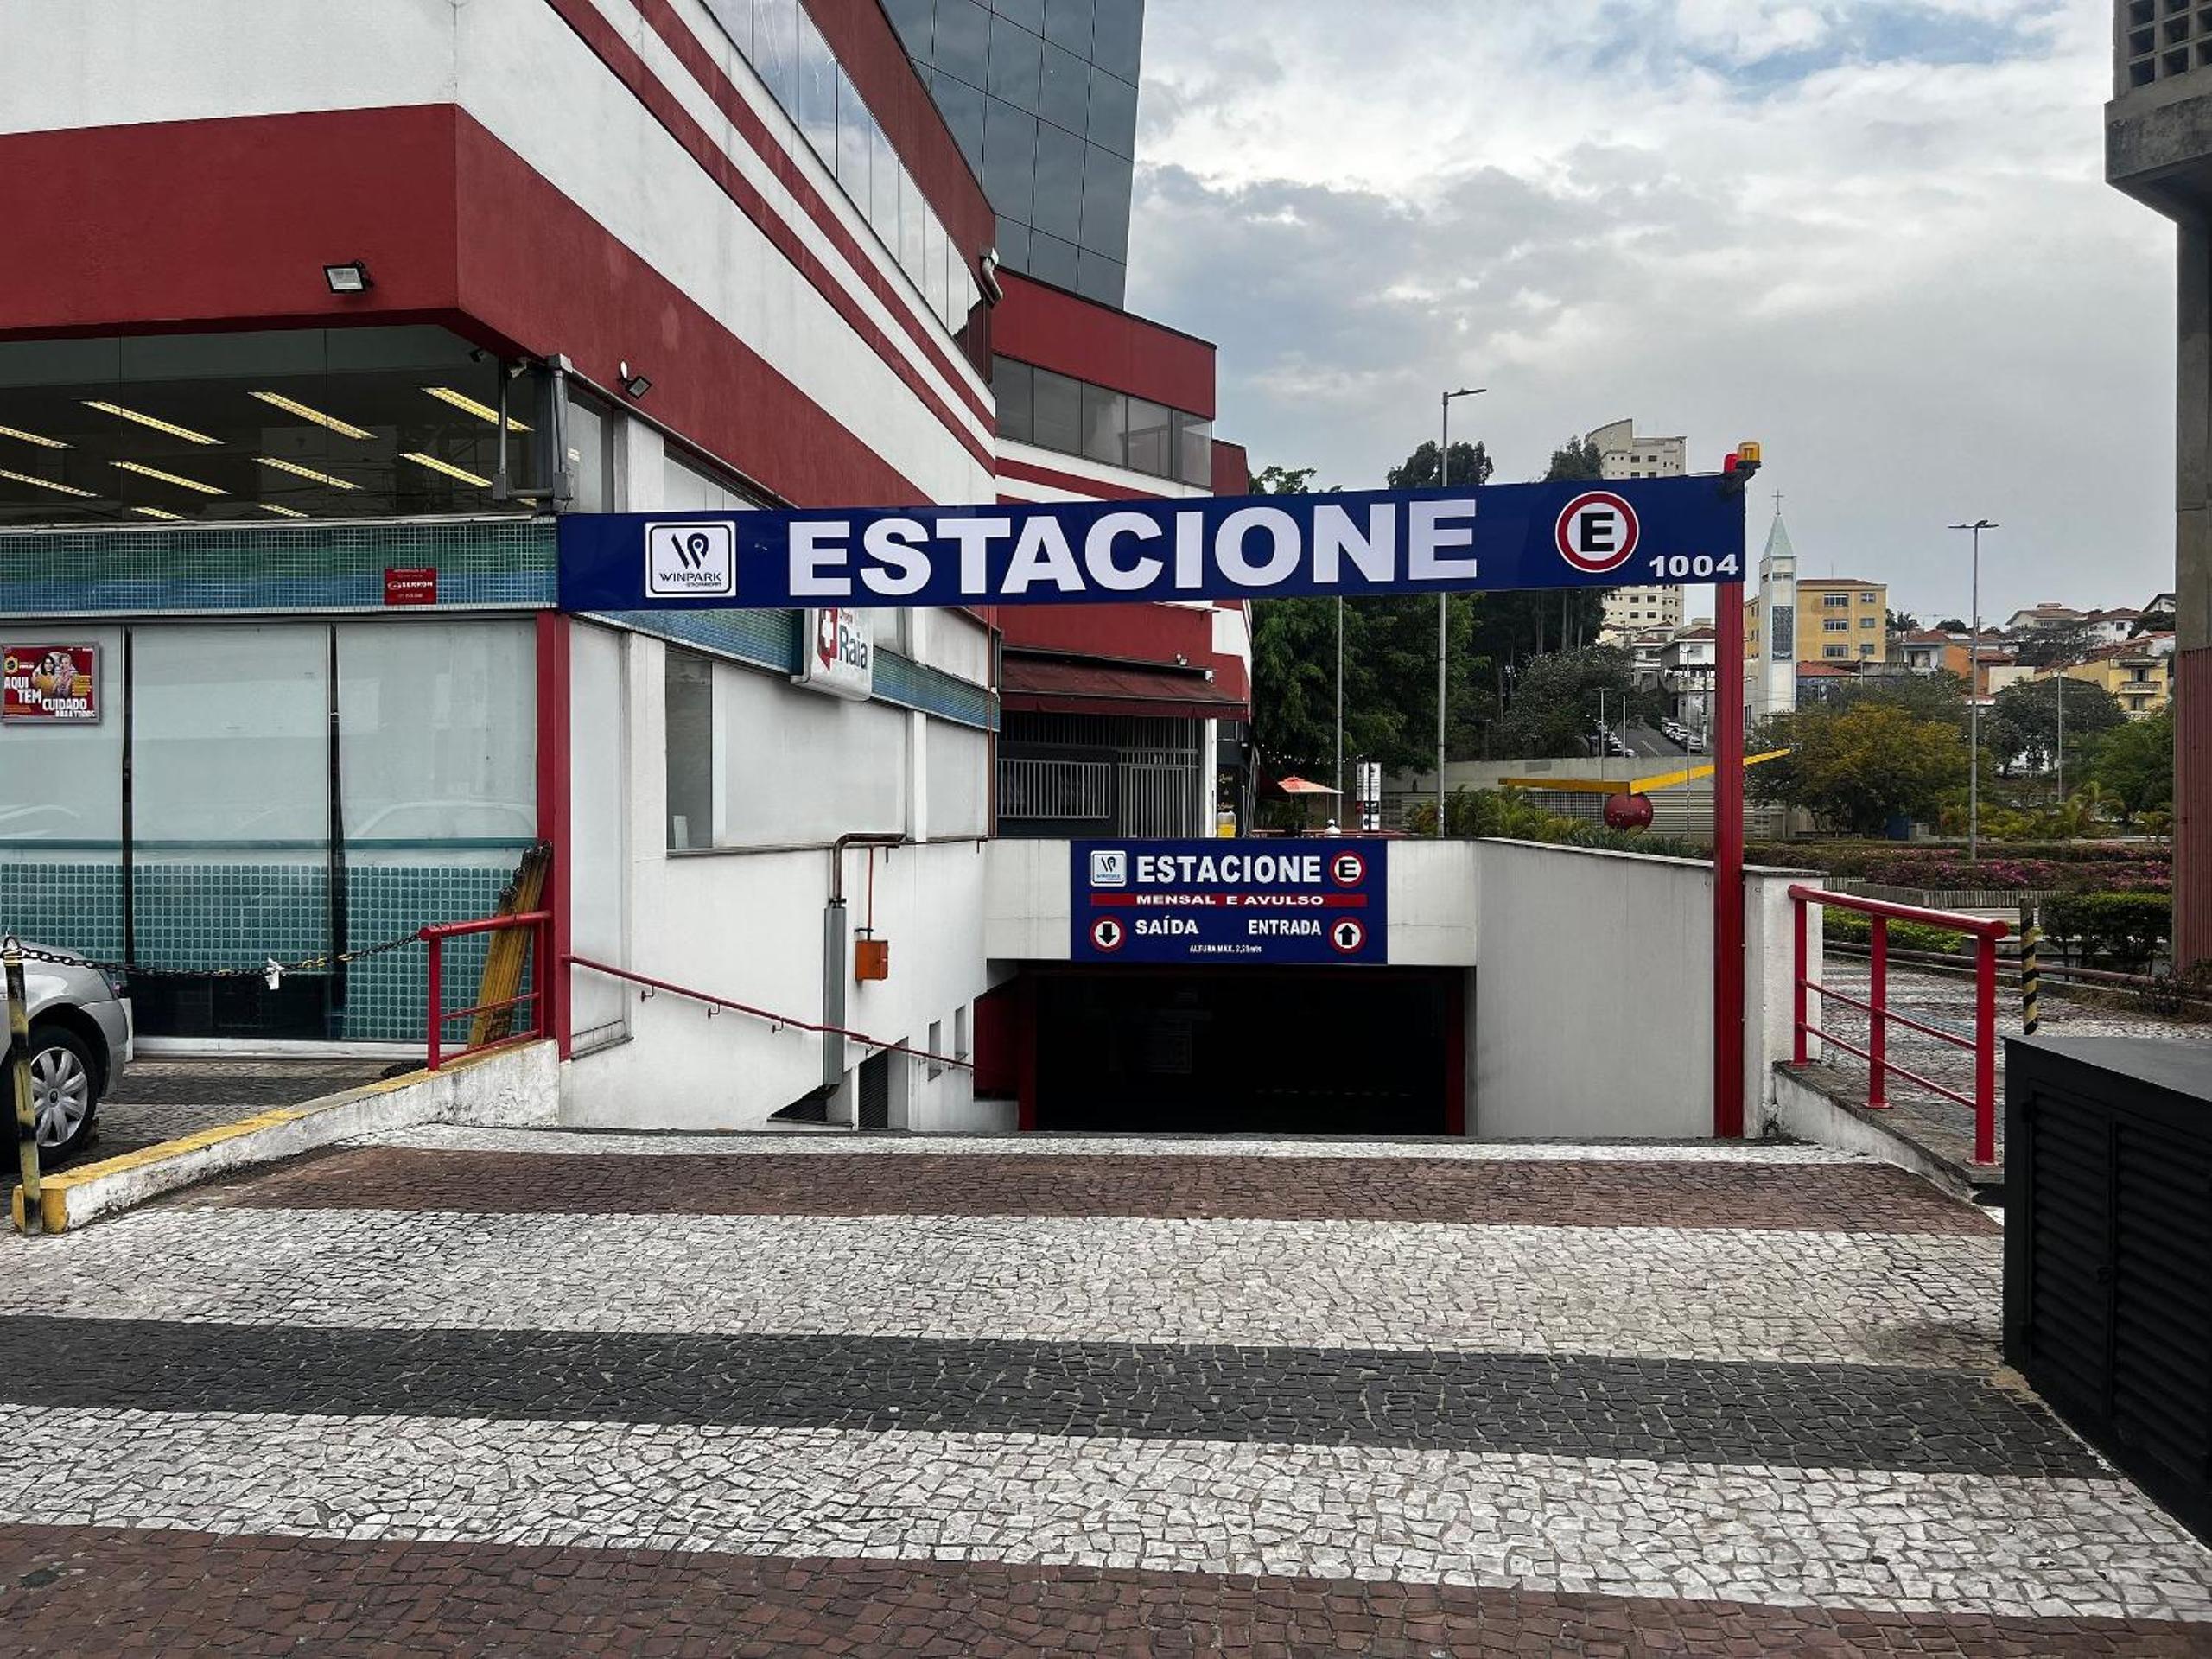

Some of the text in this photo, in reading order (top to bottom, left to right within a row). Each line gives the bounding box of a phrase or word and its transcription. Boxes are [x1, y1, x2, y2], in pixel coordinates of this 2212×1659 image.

[1580, 512, 1615, 552] E
[788, 498, 1478, 599] ESTACIONE
[1649, 554, 1739, 577] 1004
[659, 572, 722, 582] WINPARK
[839, 624, 868, 670] Raia
[3, 677, 29, 690] AQUI
[17, 689, 42, 704] TEM
[42, 698, 87, 711] CUIDADO
[1136, 855, 1322, 884] ESTACIONE
[1338, 860, 1357, 878] E
[1136, 895, 1325, 906] MENSAL E AVULSO
[1135, 915, 1199, 935] SAÍDA
[1248, 919, 1322, 936] ENTRADA
[1190, 944, 1216, 953] ALTURA
